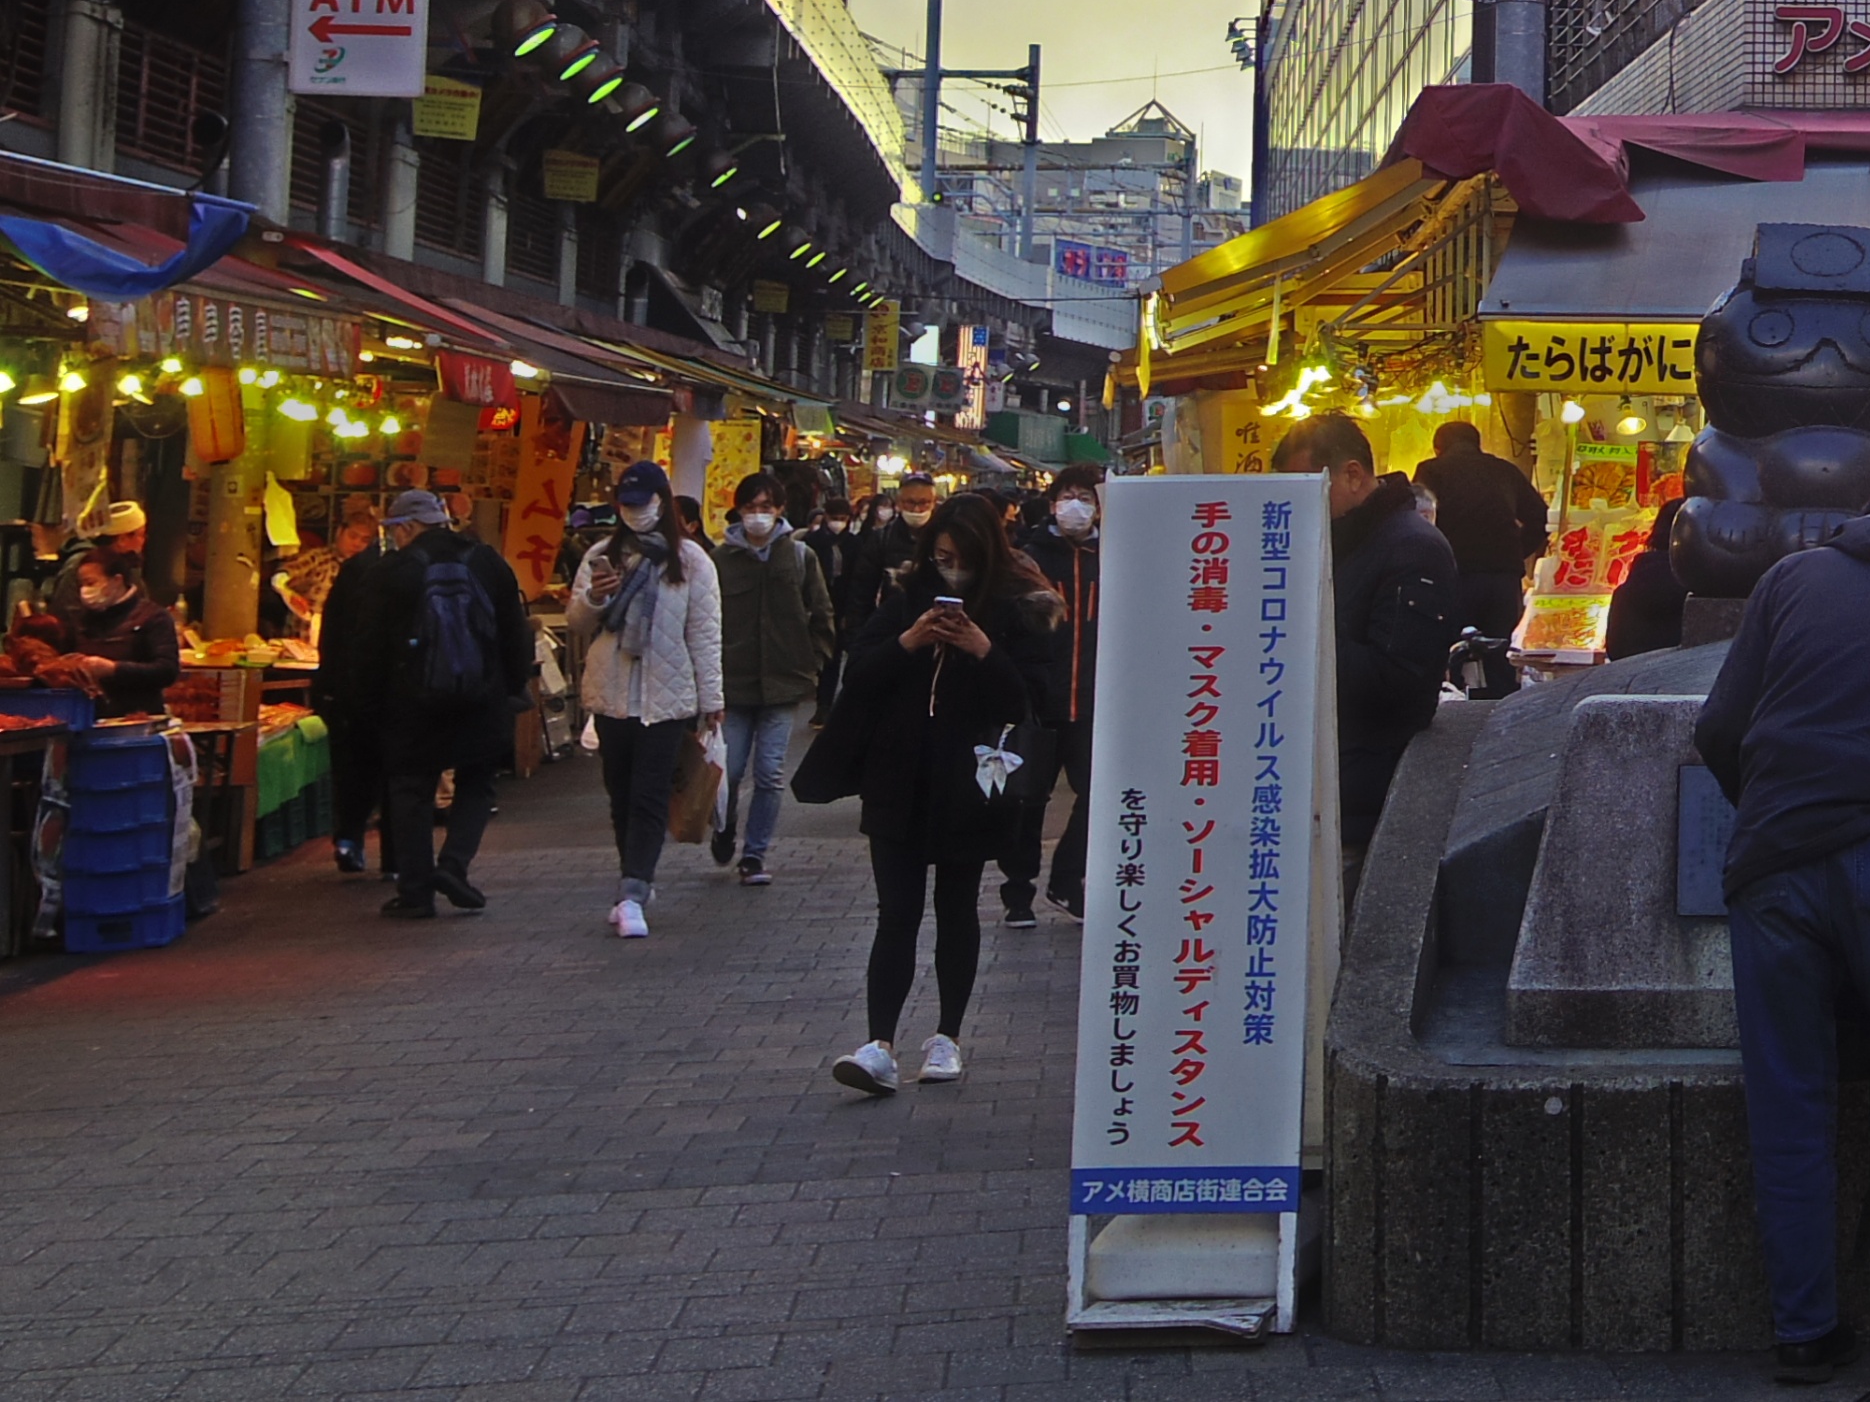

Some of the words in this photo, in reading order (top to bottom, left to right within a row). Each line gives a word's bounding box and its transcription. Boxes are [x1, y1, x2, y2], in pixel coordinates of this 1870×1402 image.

[1507, 334, 1692, 382] たらばがに
[516, 458, 564, 584] ムチ
[1167, 501, 1231, 1149] 手の消毒・マスク着用・ソーシャルディスタンス
[1241, 499, 1292, 1047] 新型コロナウイルス感染拡大防止対策
[1106, 786, 1148, 1147] を守り楽しくお買物しましょう
[1081, 1177, 1290, 1205] アメ横商店街連合会
